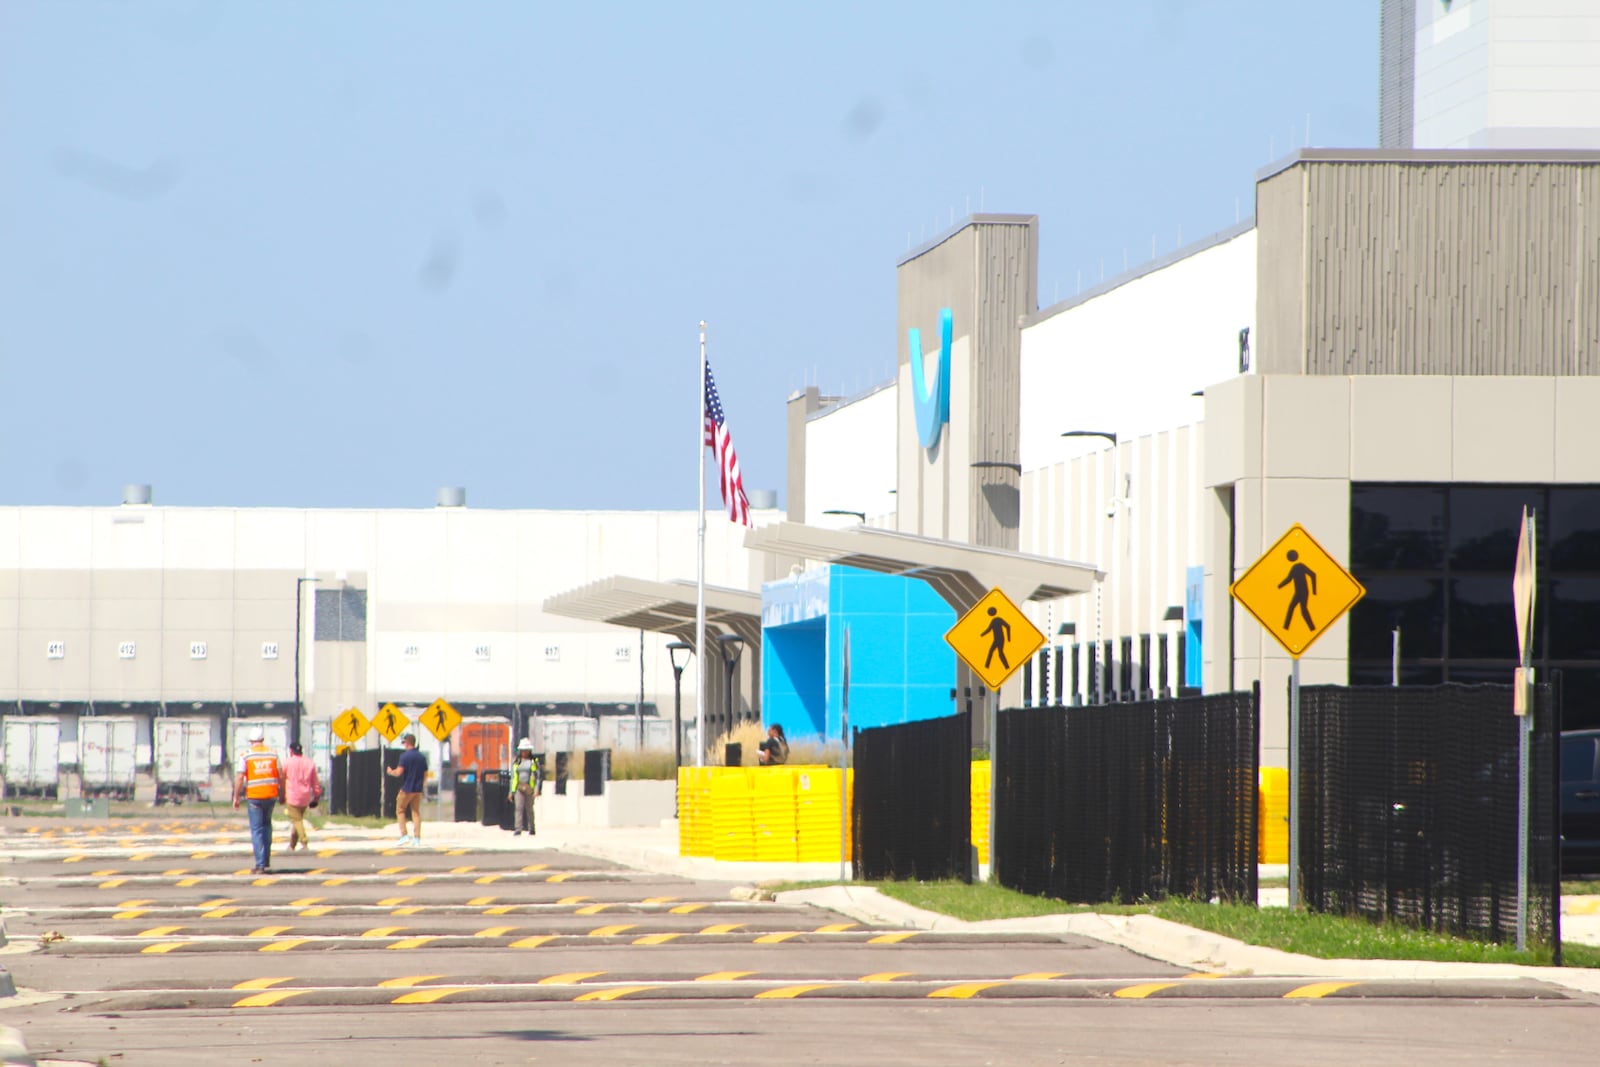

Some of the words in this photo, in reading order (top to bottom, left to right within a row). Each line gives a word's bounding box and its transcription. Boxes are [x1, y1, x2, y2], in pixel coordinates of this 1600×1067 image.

[49, 644, 63, 654] 411
[120, 645, 134, 655] 412
[192, 645, 206, 655] 413
[545, 646, 558, 655] 417
